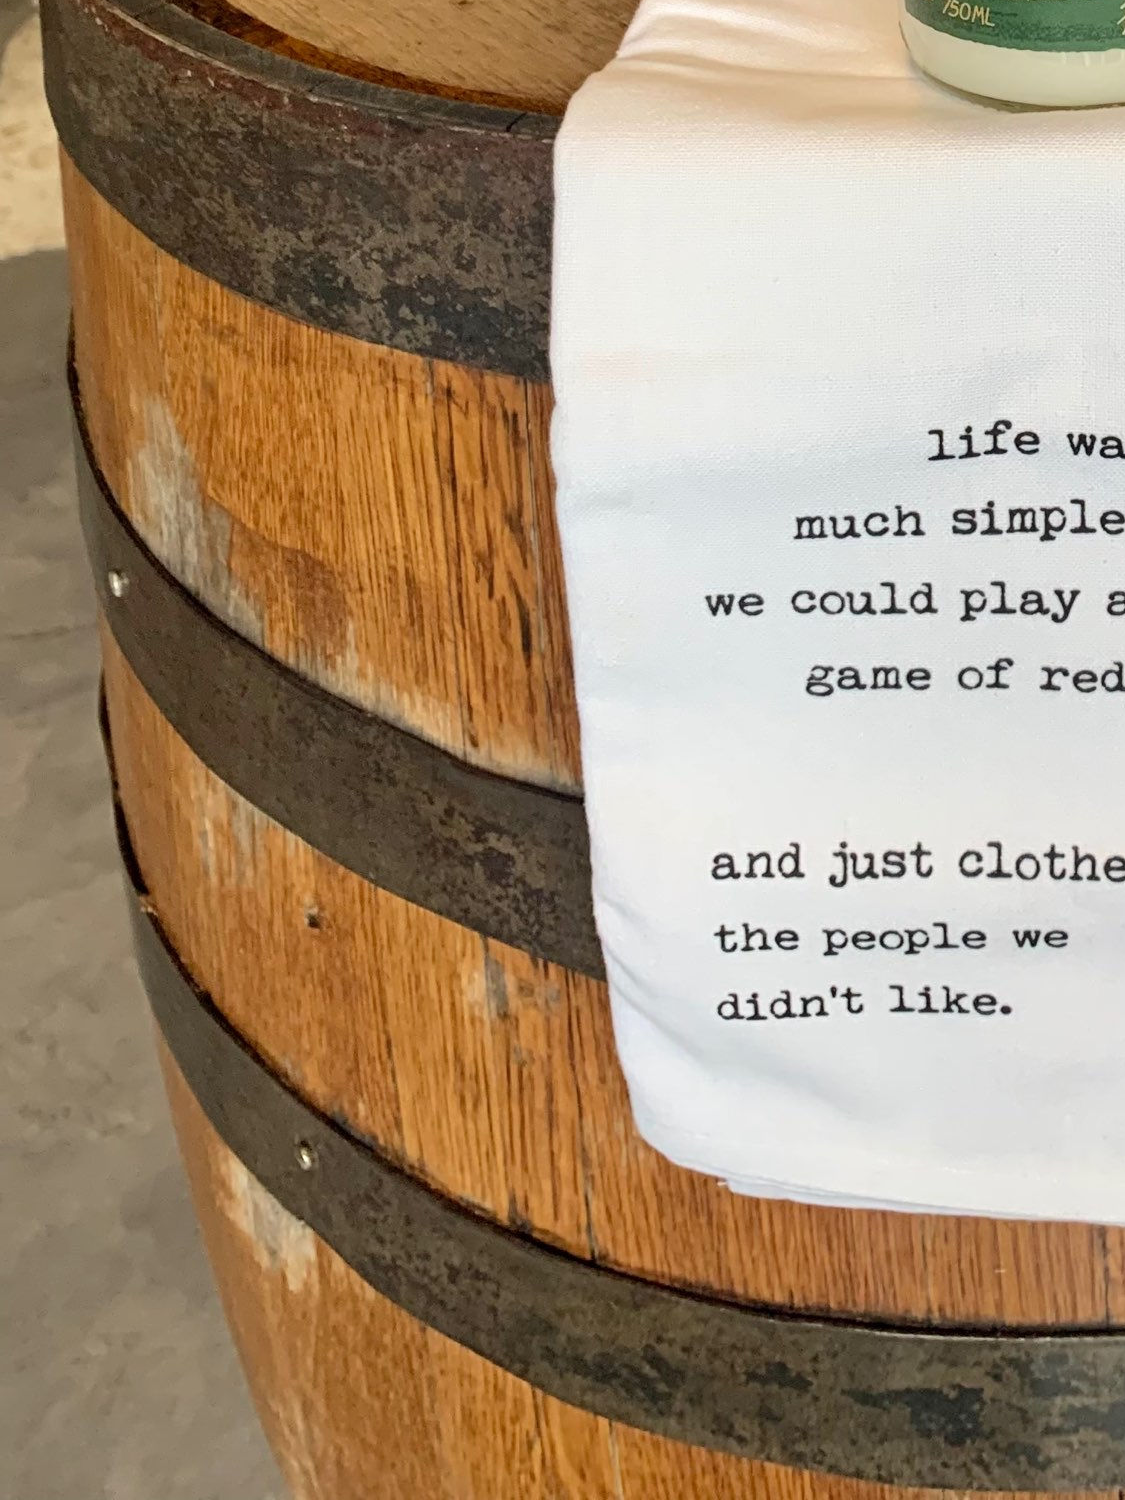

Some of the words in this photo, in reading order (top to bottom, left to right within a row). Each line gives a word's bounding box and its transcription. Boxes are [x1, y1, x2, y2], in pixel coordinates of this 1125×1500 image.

[927, 418, 1041, 462] life
[792, 504, 927, 541] much
[704, 592, 765, 618] we
[790, 581, 939, 616] could
[959, 580, 1082, 624] play
[804, 664, 932, 698] game
[957, 657, 1015, 691] of
[710, 841, 806, 881] and
[827, 840, 934, 889] just
[713, 922, 800, 954] the
[821, 921, 988, 957] people
[1011, 929, 1069, 949] we
[716, 984, 865, 1022] didn't
[888, 984, 1013, 1017] like.
